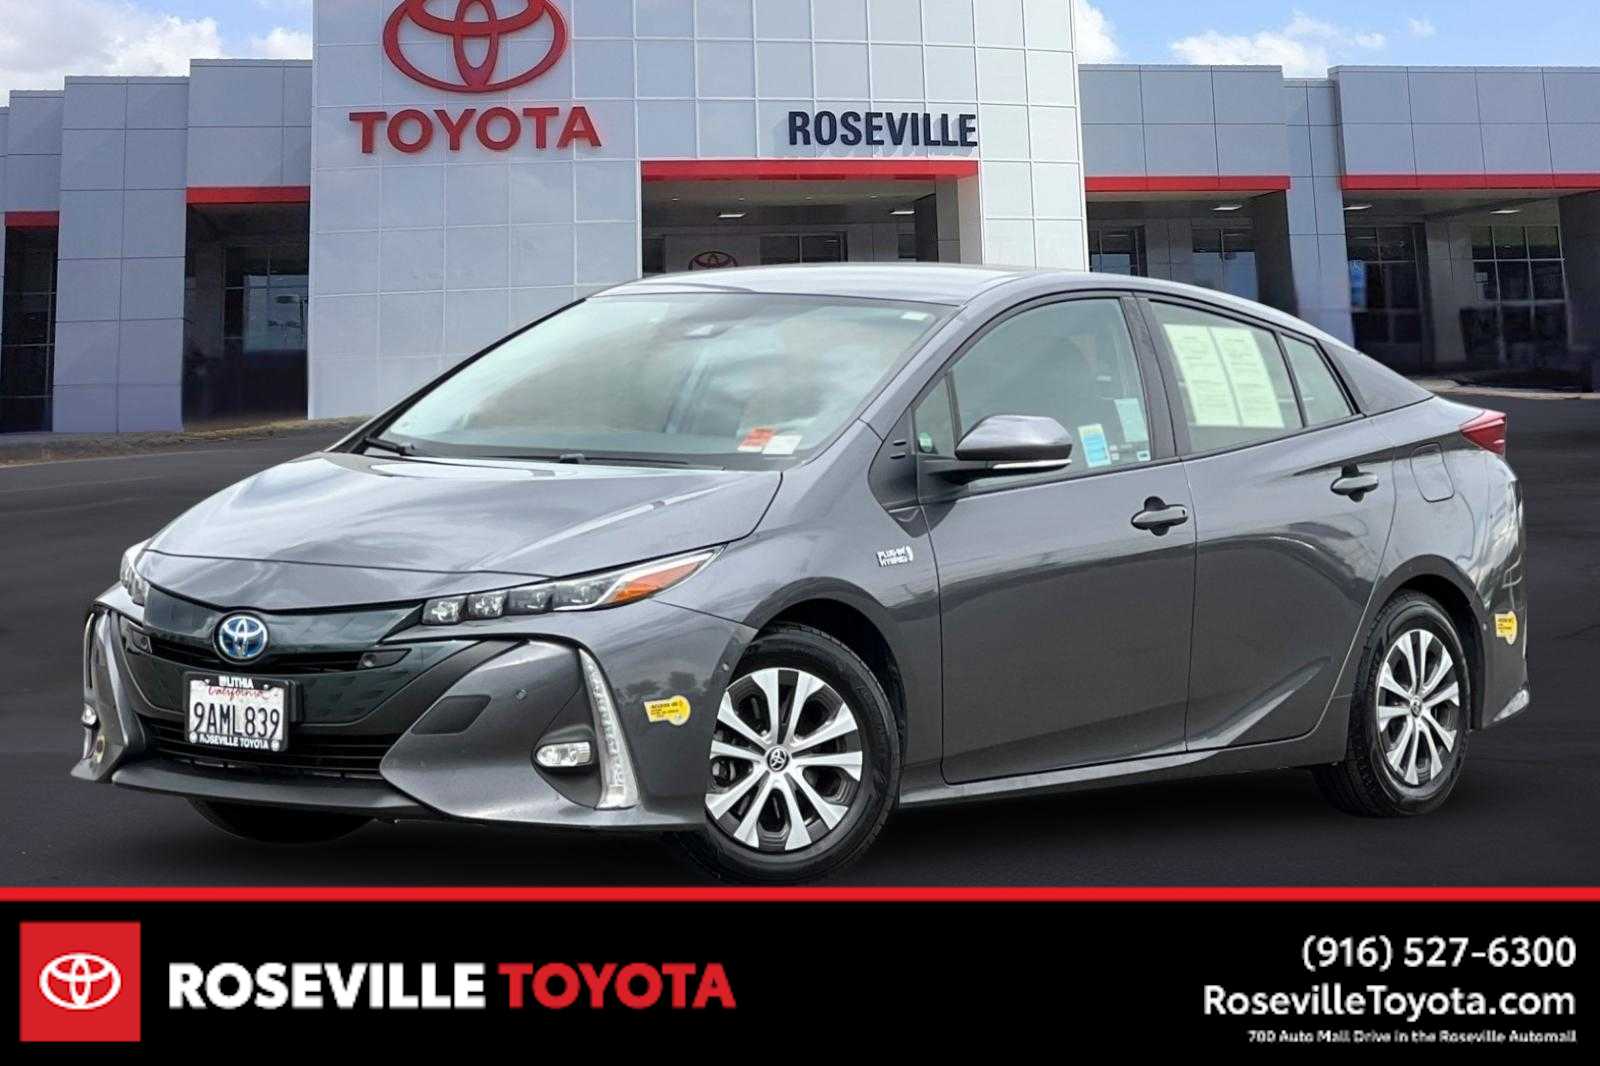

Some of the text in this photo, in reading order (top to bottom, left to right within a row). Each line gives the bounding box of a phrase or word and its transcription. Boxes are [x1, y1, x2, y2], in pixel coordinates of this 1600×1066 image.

[349, 106, 602, 154] TOYOTA
[789, 110, 978, 147] ROSEVILLE
[193, 701, 281, 740] 9AML839
[199, 733, 270, 750] ROSEVILLE TOYOTA
